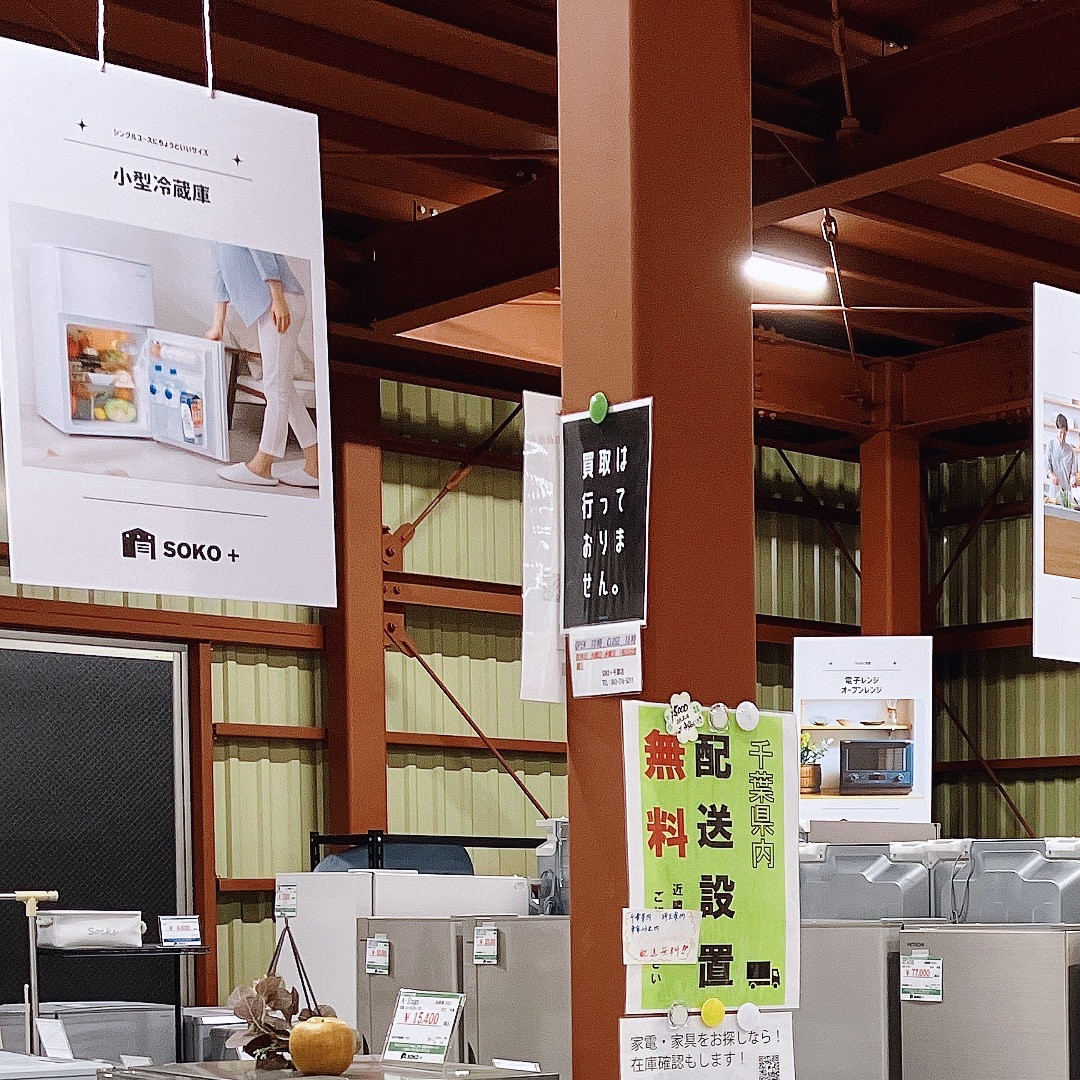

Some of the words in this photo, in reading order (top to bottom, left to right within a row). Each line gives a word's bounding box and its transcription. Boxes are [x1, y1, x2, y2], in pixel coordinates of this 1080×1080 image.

[113, 166, 211, 204] 小型冷蔵庫
[582, 446, 628, 481] 買取は
[581, 487, 625, 520] 行って
[163, 540, 222, 562] SOKO
[582, 527, 625, 559] おりま
[582, 570, 619, 599] せん。
[845, 676, 880, 685] 電子レンジ
[644, 728, 688, 858] 無料
[749, 740, 775, 869] 千葉県内
[695, 733, 736, 989] 配送設置
[630, 1051, 745, 1073] 在庫確認もします！
